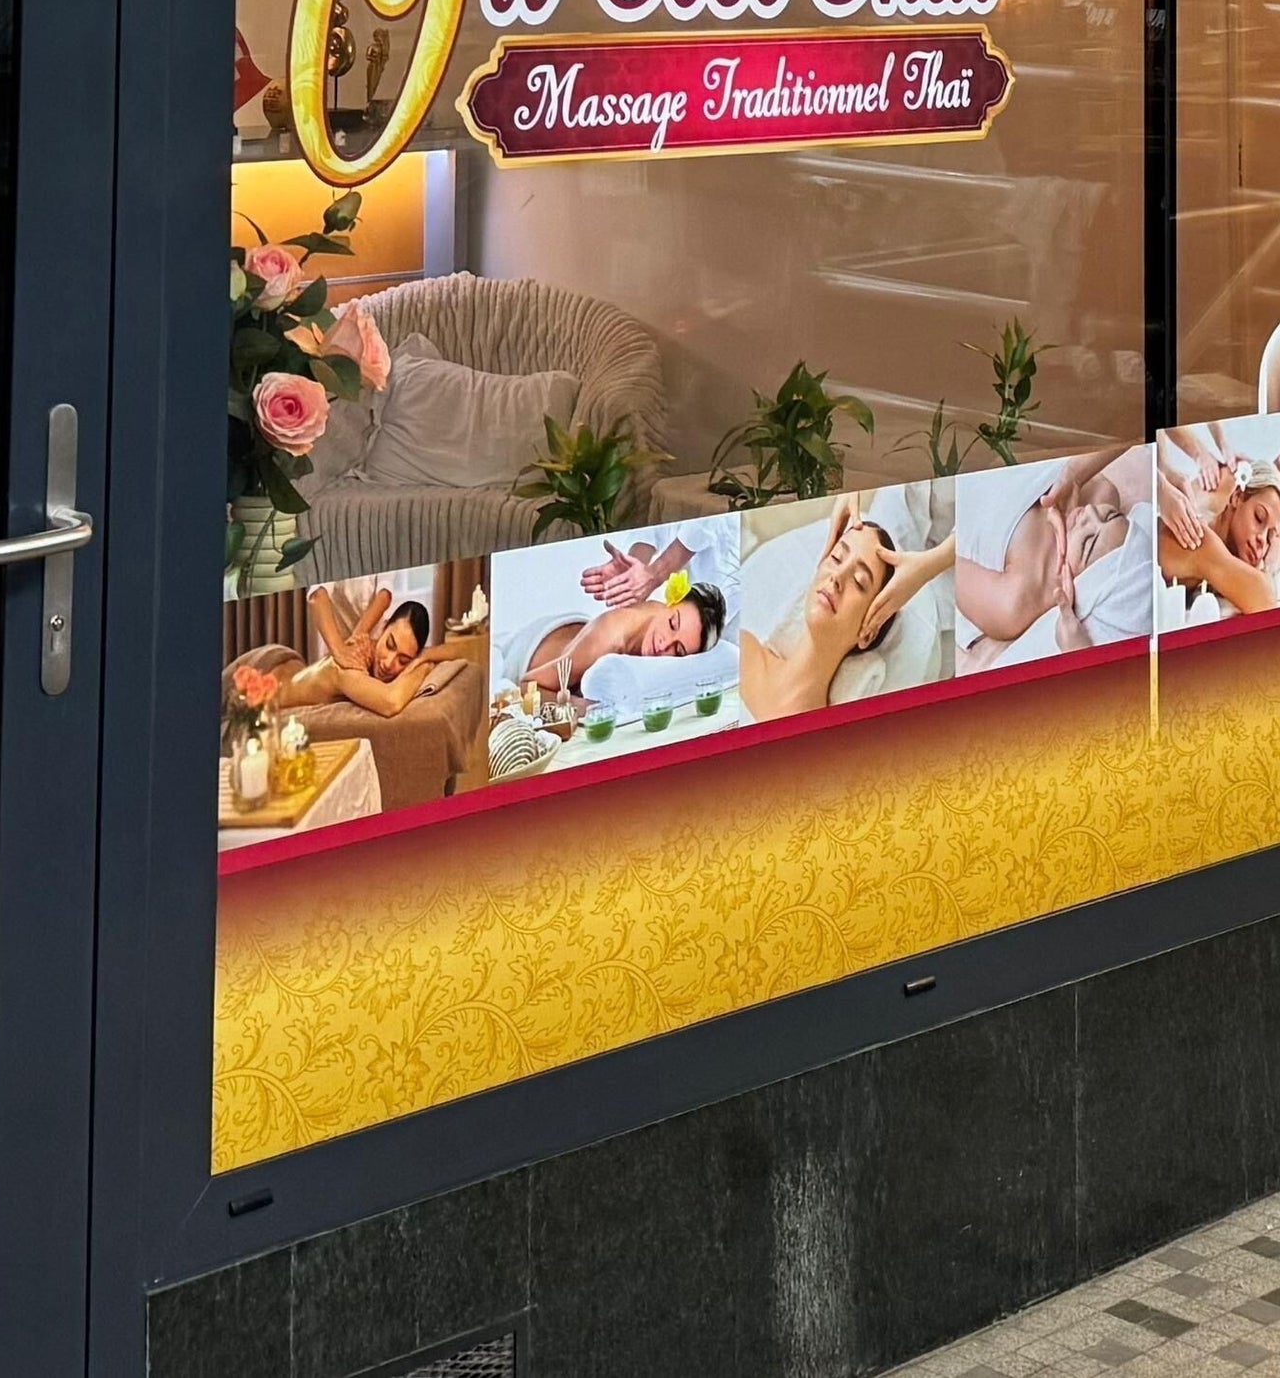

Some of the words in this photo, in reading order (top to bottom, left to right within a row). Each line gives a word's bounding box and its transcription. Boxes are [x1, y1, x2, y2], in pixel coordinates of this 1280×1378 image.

[514, 63, 687, 153] Massage
[703, 51, 895, 121] Traditionnel
[903, 50, 973, 110] Thaï
